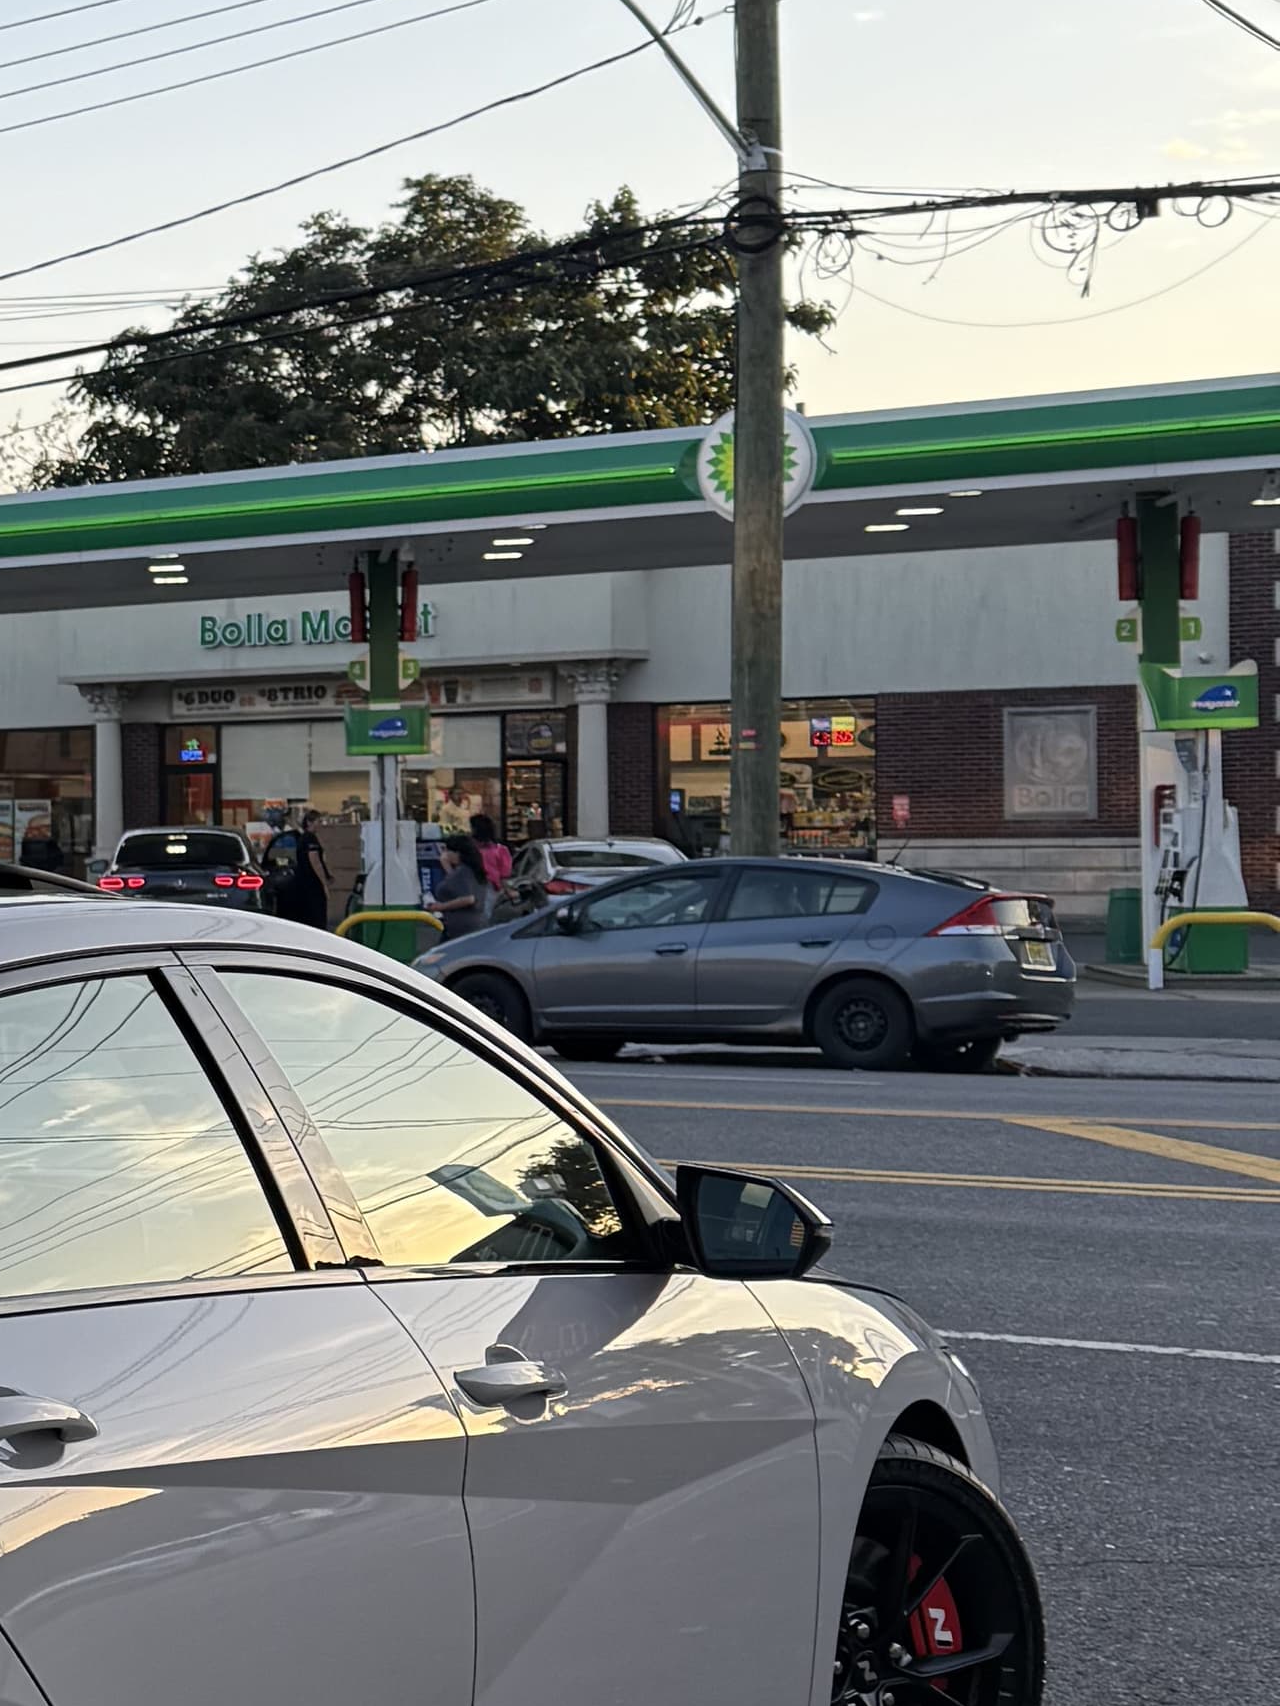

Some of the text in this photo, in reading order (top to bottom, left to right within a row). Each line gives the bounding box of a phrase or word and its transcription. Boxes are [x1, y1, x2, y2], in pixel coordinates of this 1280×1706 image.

[200, 613, 289, 646] Bolla
[1120, 624, 1131, 636] 2
[197, 689, 236, 704] DUO
[279, 685, 327, 700] TRIO
[1018, 787, 1087, 807] Bolla
